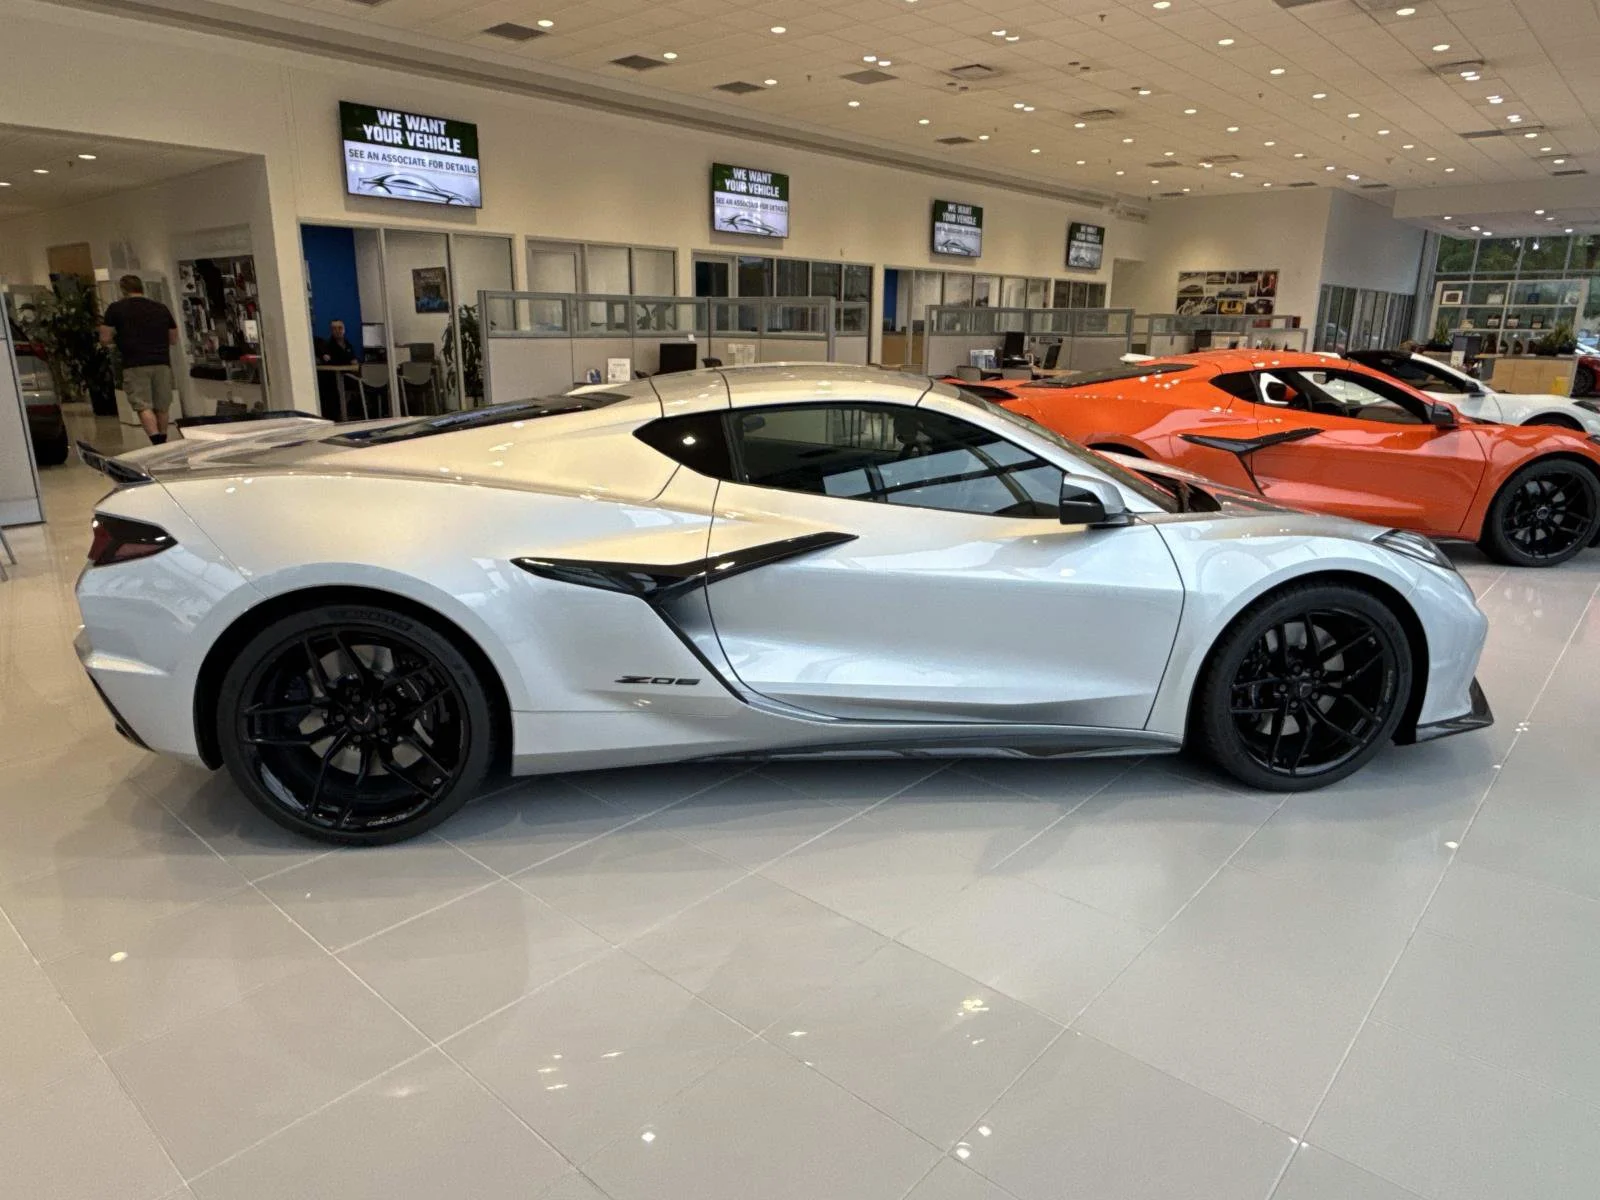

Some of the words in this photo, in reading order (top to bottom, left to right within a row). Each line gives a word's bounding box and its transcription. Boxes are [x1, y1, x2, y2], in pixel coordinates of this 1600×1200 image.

[377, 110, 402, 128] WE
[405, 114, 447, 135] WANT
[363, 123, 403, 145] YOUR
[406, 131, 462, 153] VEHICLE
[349, 148, 365, 159] SEE
[367, 151, 379, 161] AN
[382, 153, 426, 168] ASSOCIATE
[429, 160, 444, 170] FOR
[446, 162, 477, 174] DETAILS
[725, 179, 747, 192] YOUR
[748, 182, 780, 198] VEHICLE
[733, 168, 747, 180] WE
[748, 170, 772, 184] WANT
